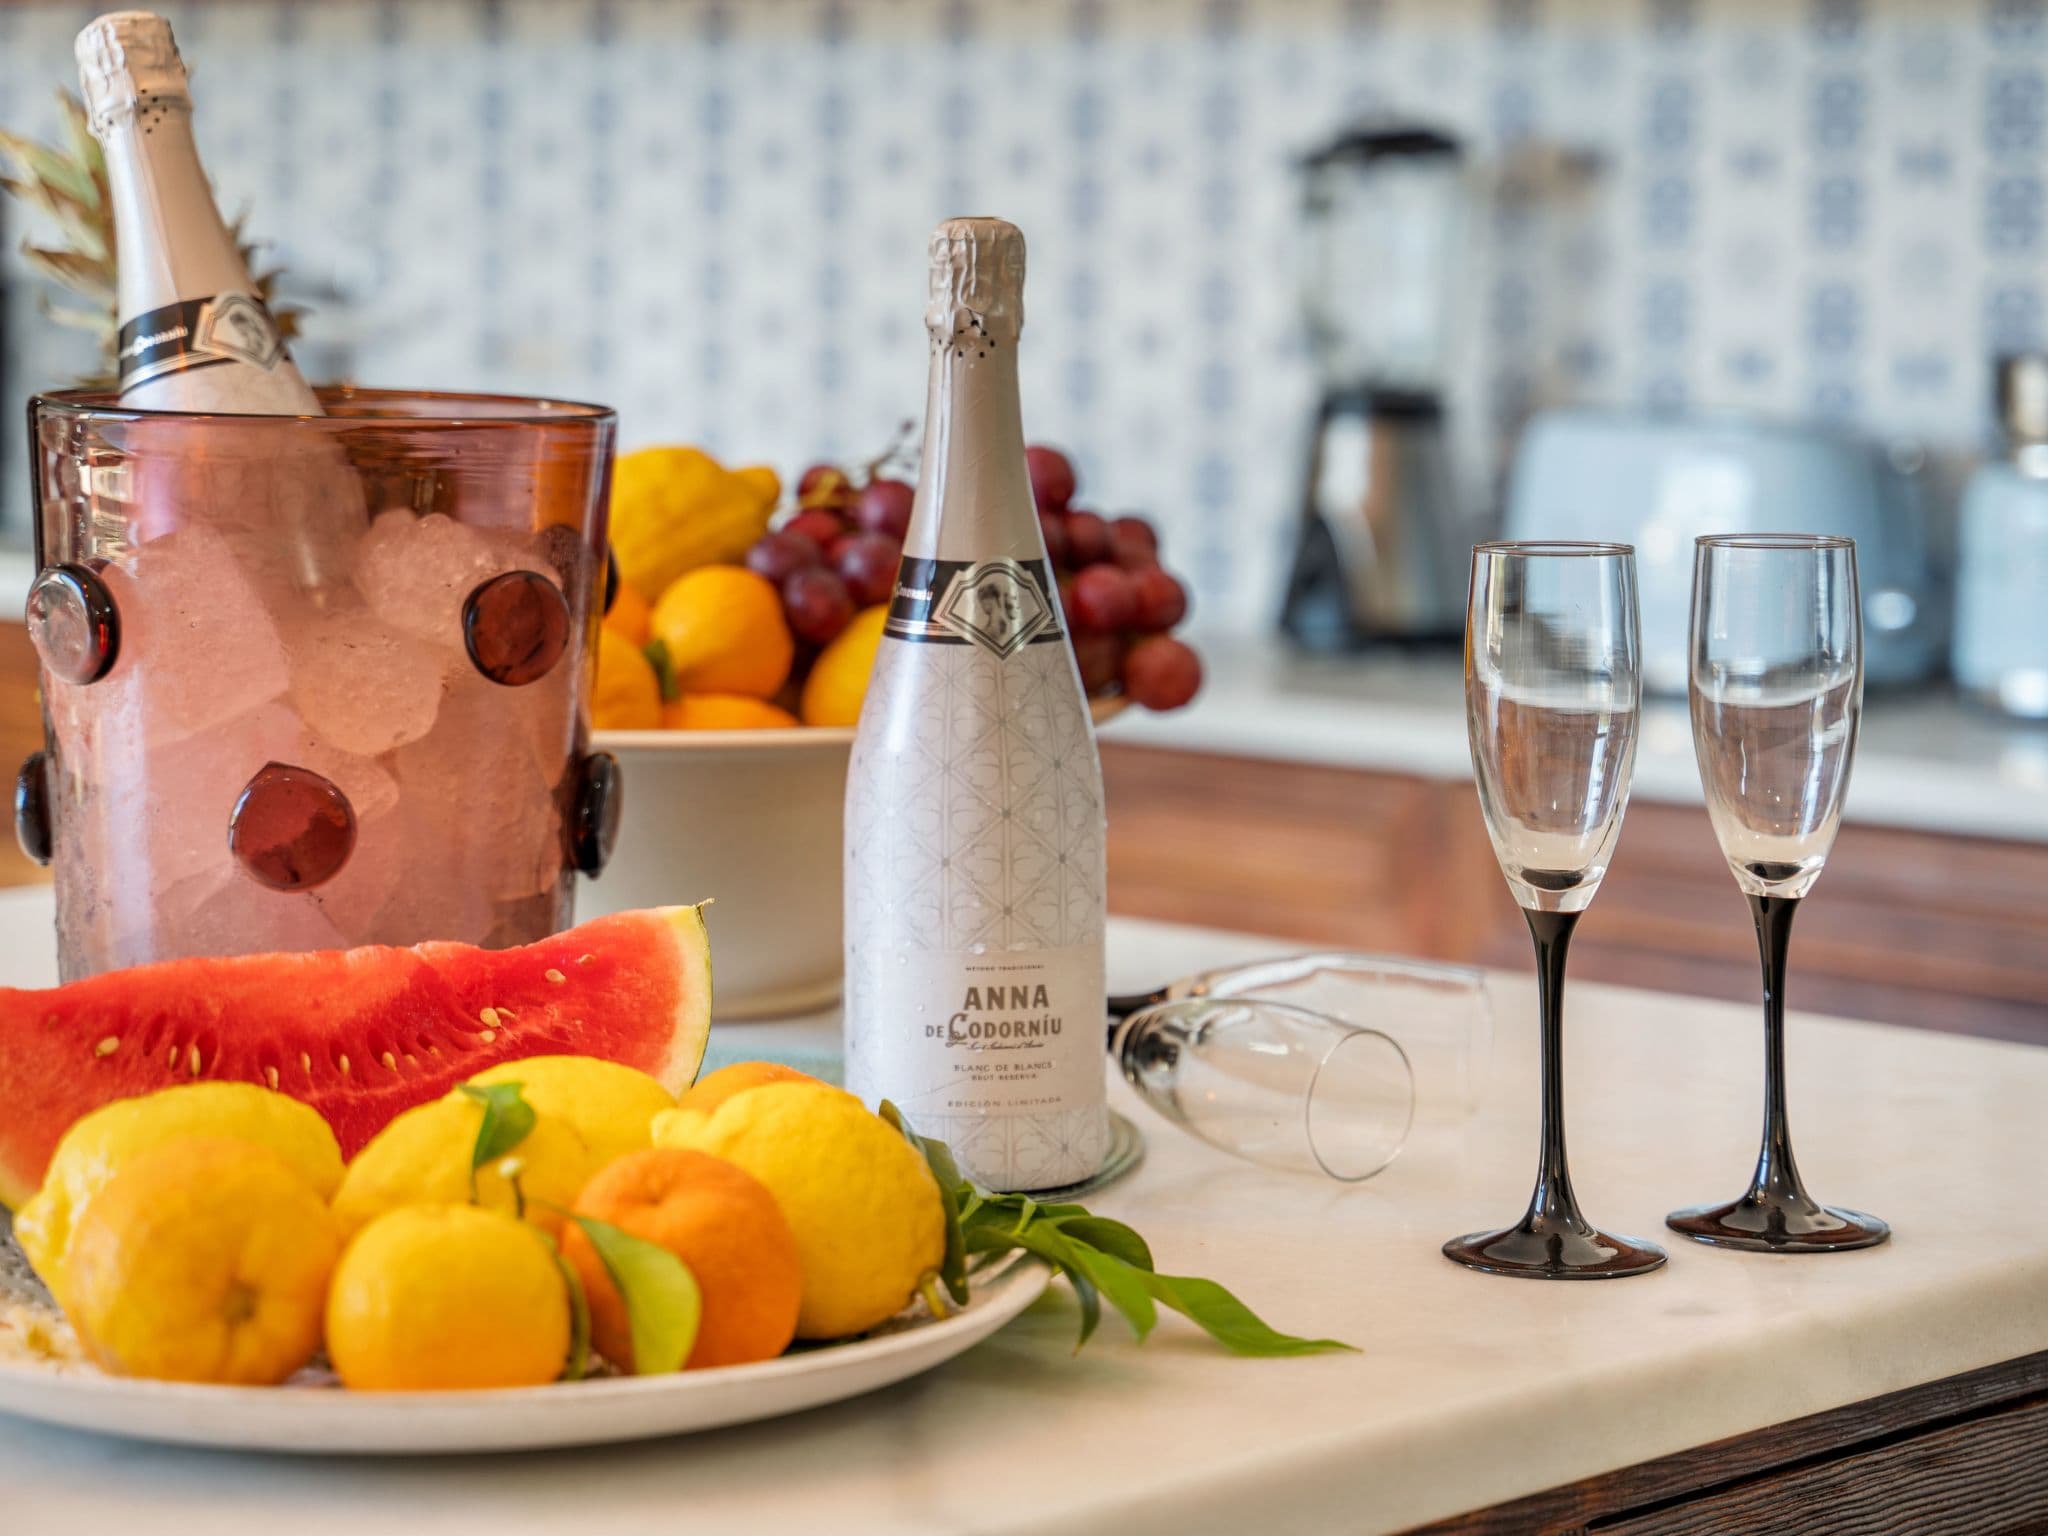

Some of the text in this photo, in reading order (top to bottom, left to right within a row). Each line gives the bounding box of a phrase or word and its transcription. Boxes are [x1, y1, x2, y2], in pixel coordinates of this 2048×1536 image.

[963, 984, 1050, 1010] ANNA
[925, 1025, 944, 1038] DE
[953, 1064, 990, 1072] BLANC
[995, 1064, 1009, 1072] DE
